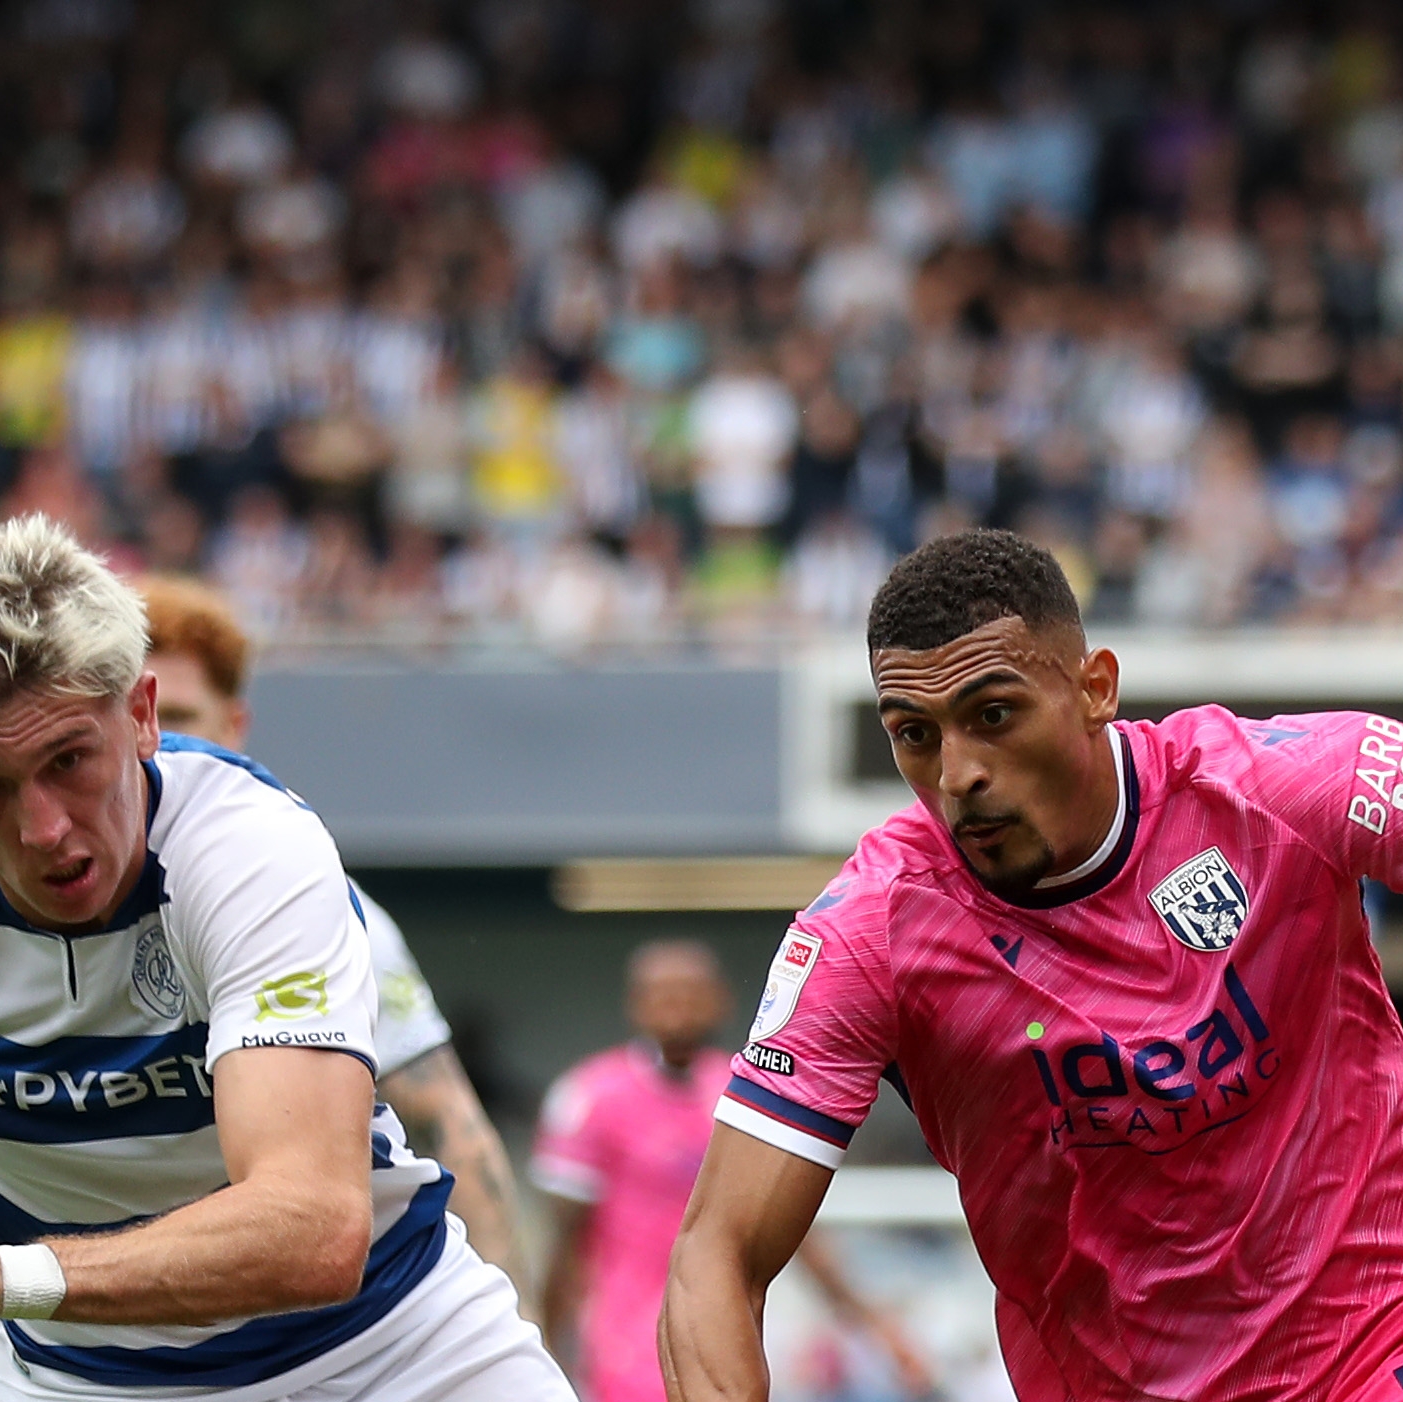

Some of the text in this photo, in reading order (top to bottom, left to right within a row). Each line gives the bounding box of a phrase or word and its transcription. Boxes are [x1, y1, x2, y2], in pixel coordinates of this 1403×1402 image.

[1160, 860, 1222, 910] ALBION
[787, 943, 809, 963] bet
[241, 1031, 347, 1048] MuGuava
[1026, 962, 1270, 1106] ideal
[1051, 1048, 1280, 1144] HEATING
